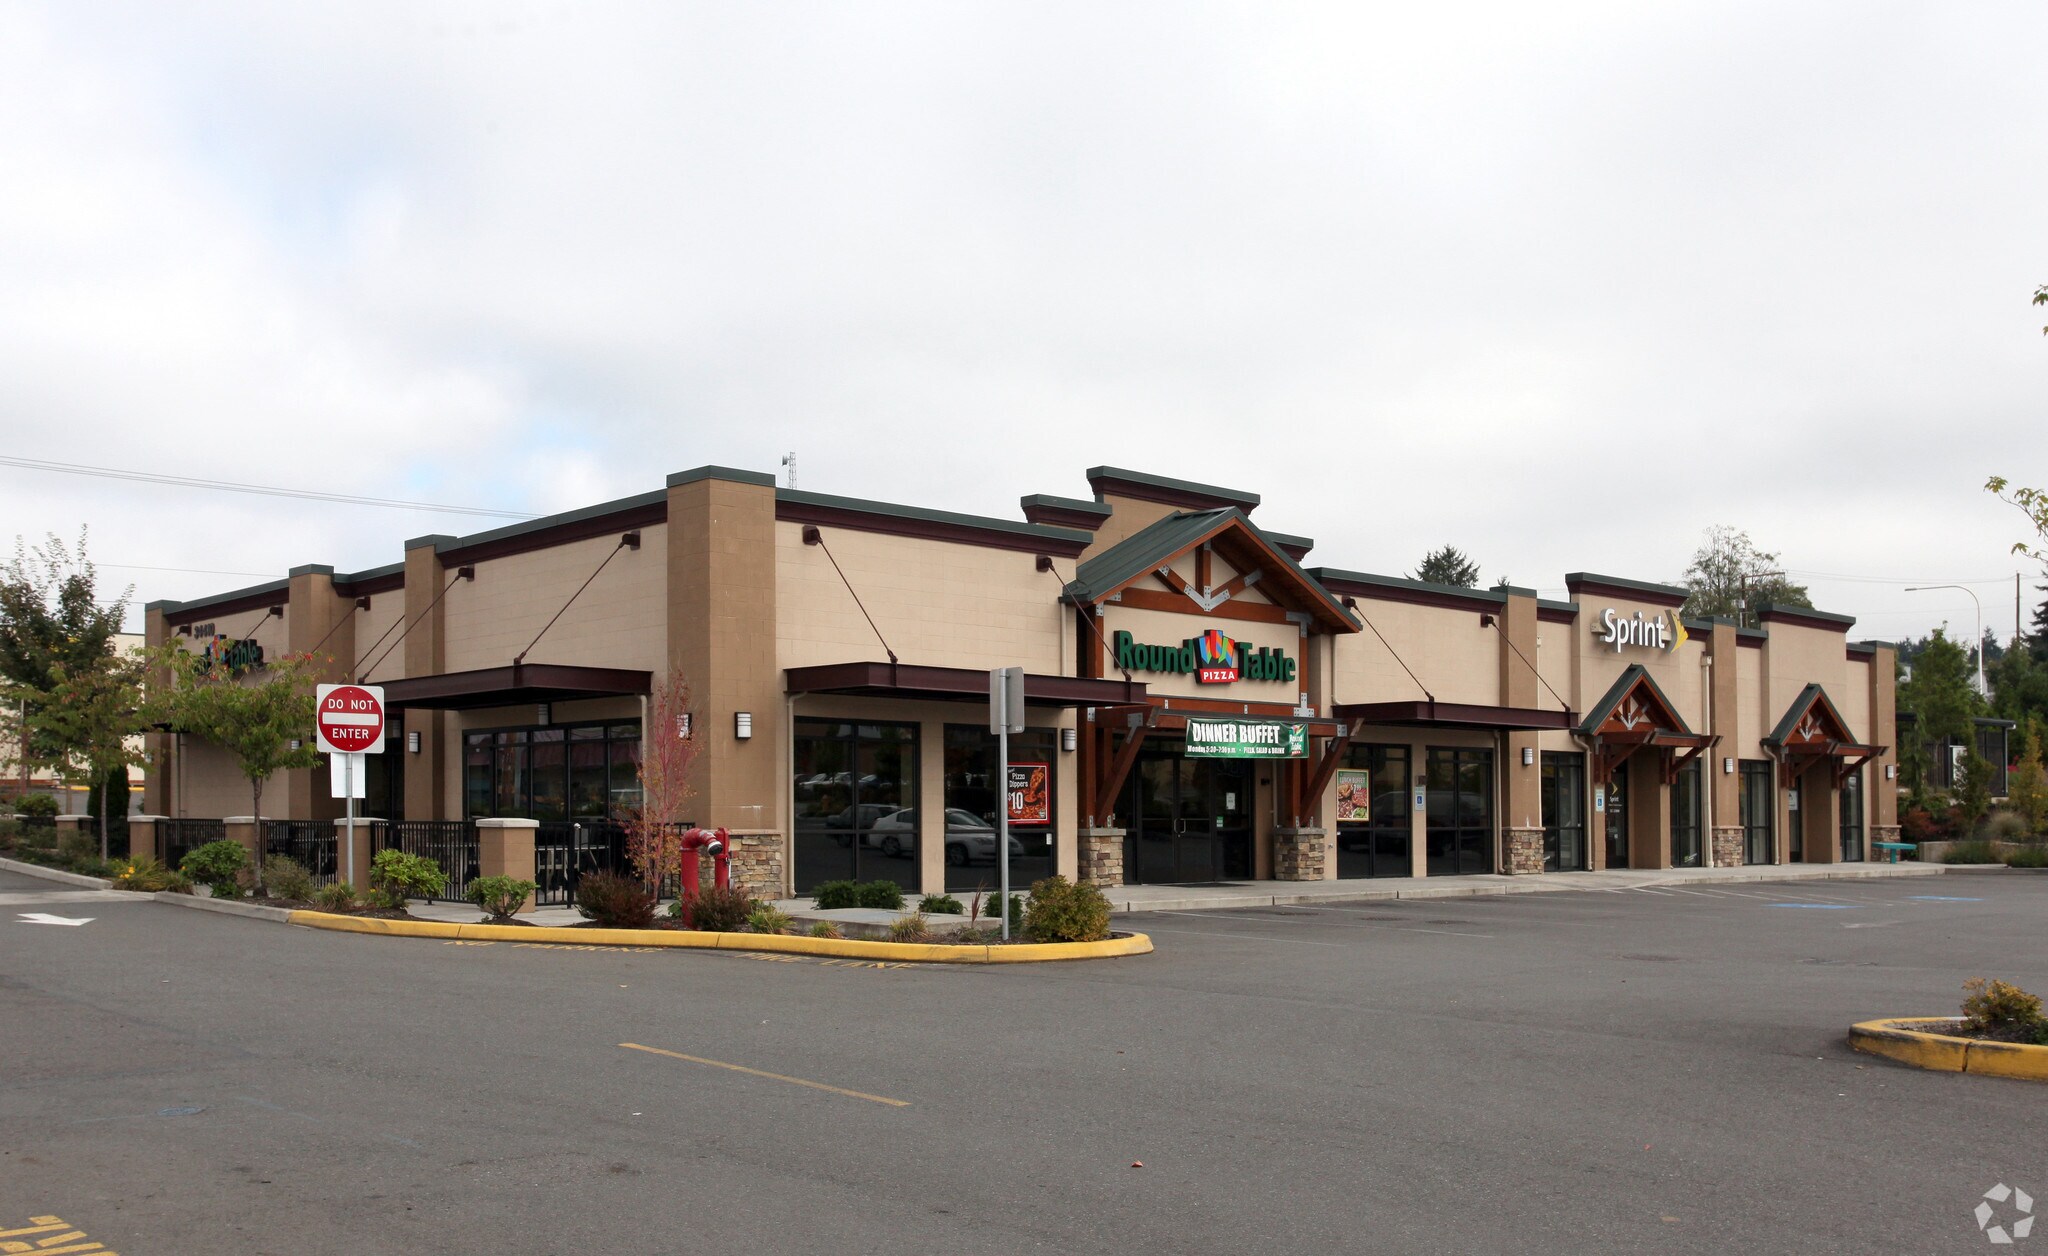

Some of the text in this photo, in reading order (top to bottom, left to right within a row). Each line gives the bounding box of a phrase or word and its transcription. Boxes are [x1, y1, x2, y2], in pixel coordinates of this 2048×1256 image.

[1602, 608, 1665, 653] Sprint
[1115, 630, 1296, 682] Round Table
[1203, 671, 1235, 680] PIZZA
[328, 699, 373, 710] DO NOT
[332, 728, 369, 739] ENTER
[1192, 722, 1280, 744] DINNER BUFFET
[1008, 792, 1023, 809] $10
